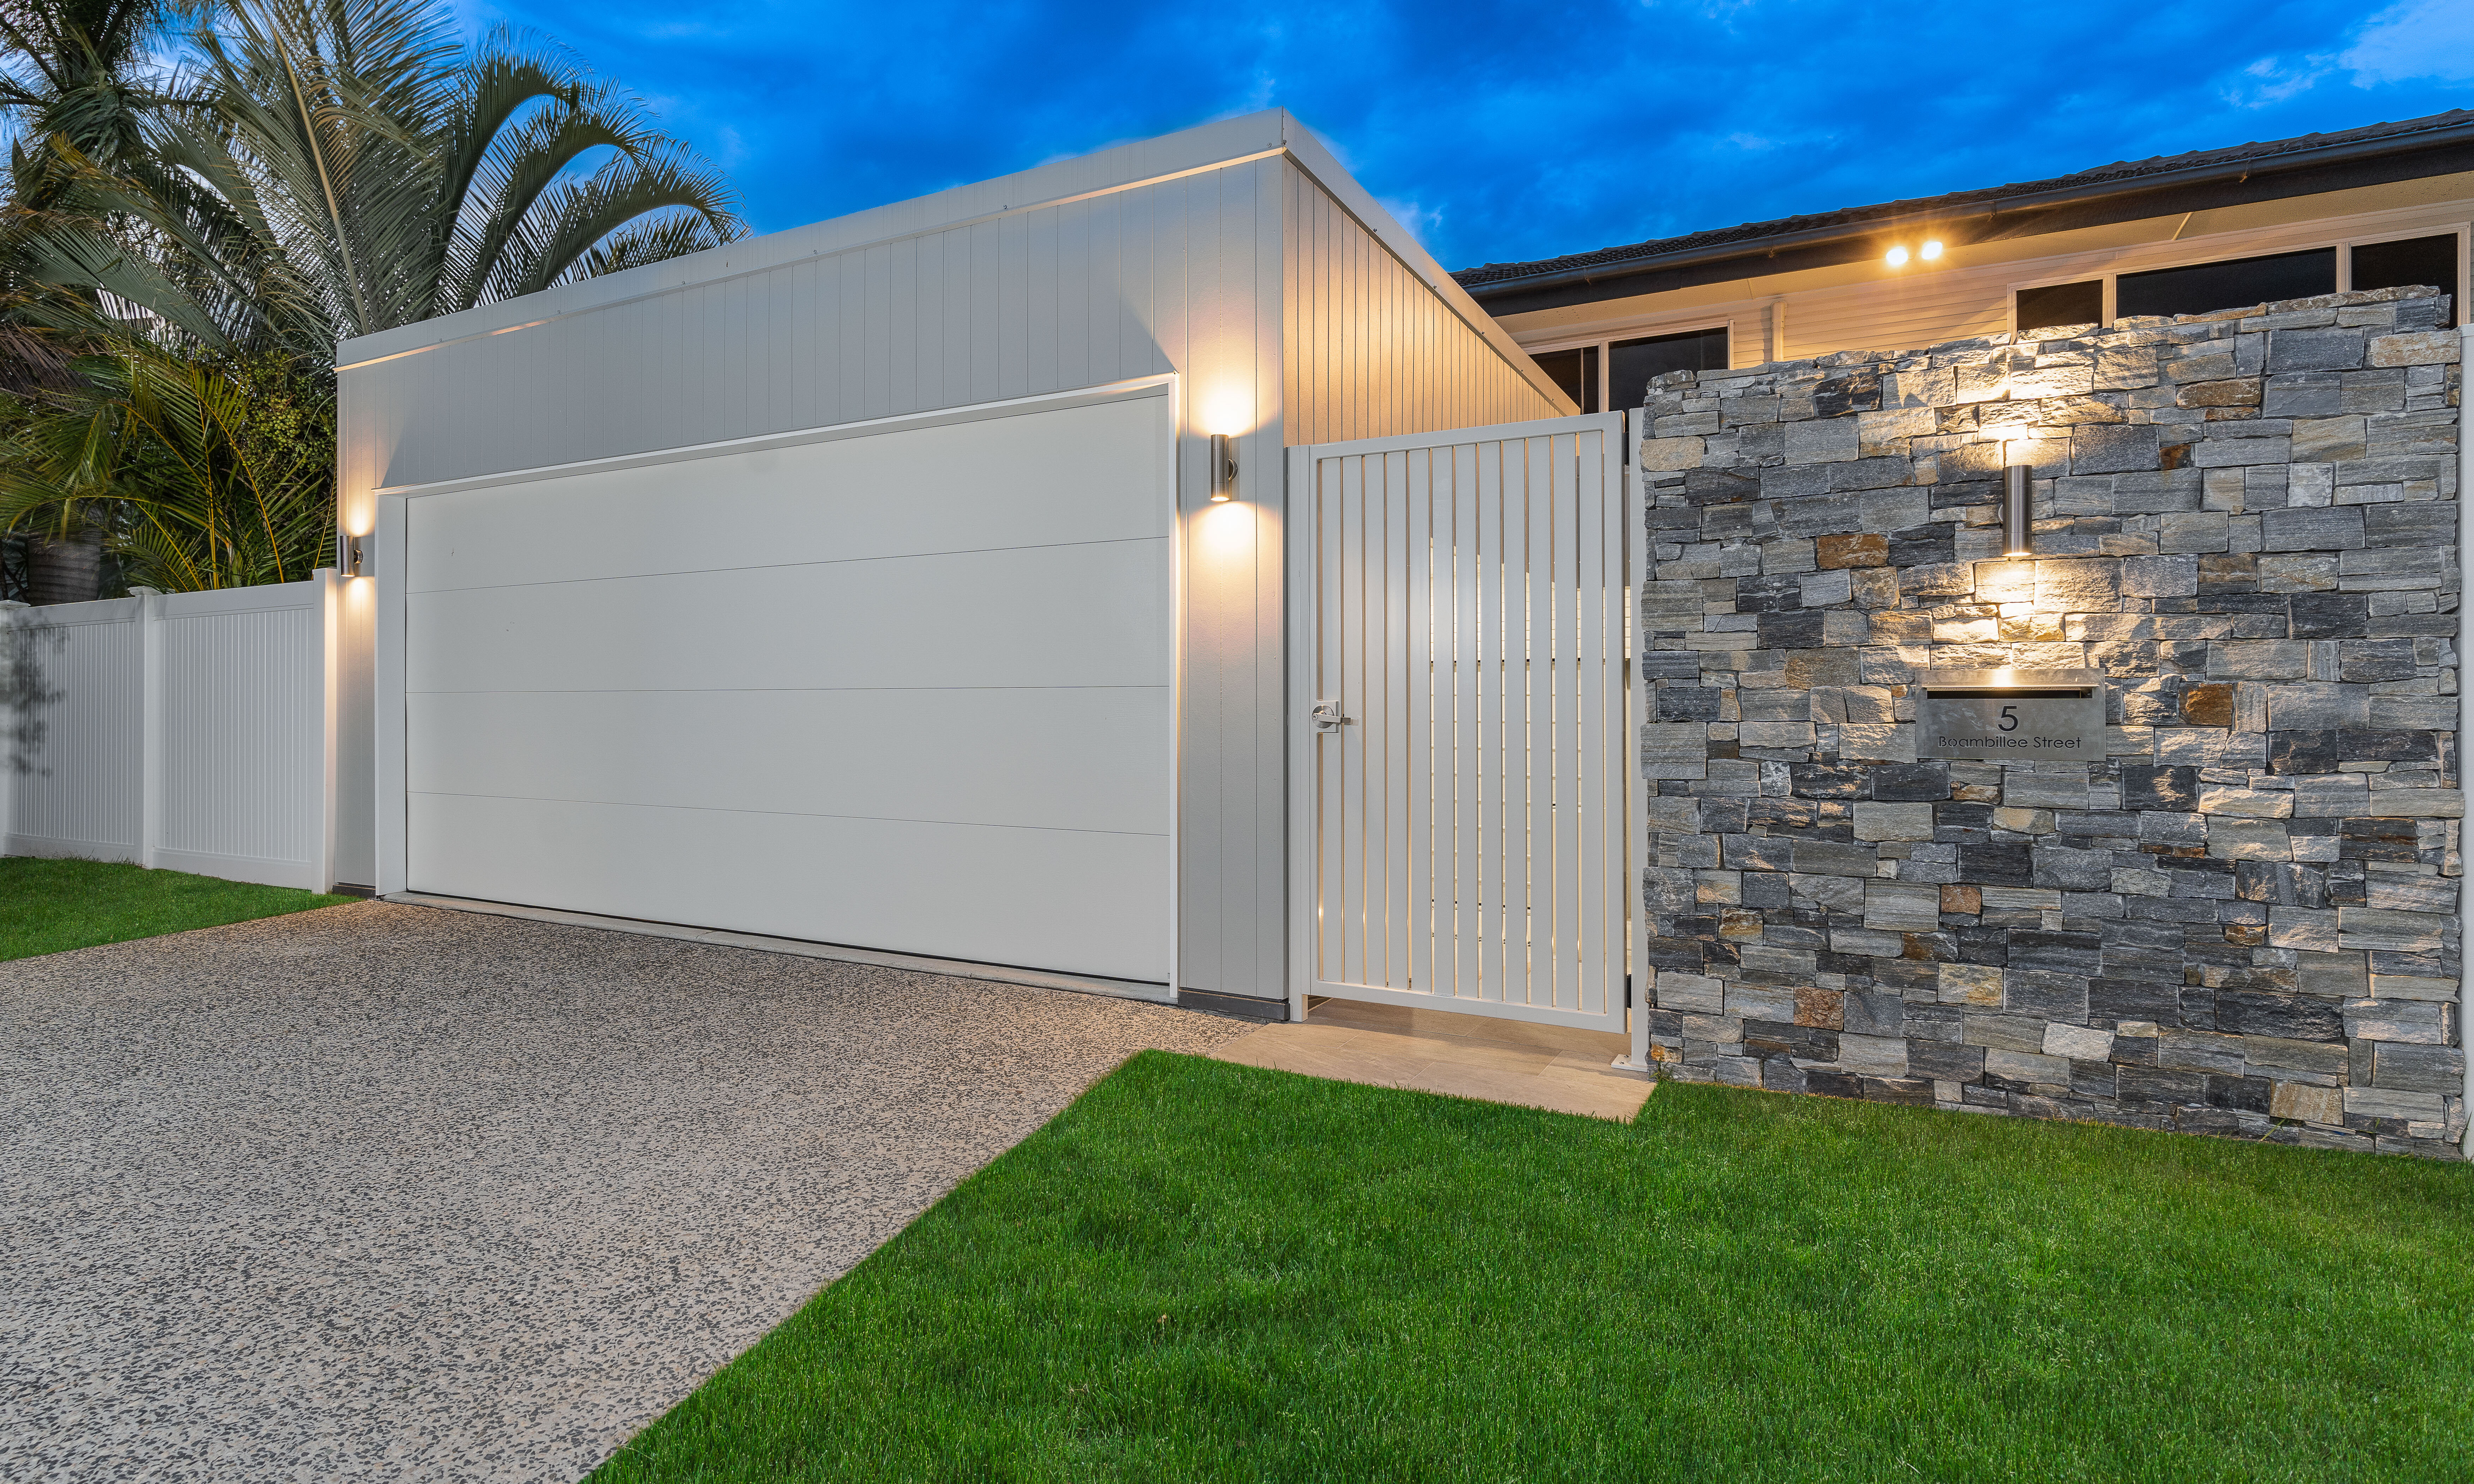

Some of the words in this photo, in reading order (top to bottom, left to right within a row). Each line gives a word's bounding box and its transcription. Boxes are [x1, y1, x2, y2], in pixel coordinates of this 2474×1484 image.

[1998, 705, 2018, 732] 5
[1938, 736, 2028, 748] Boambillee
[2033, 737, 2081, 749] Street
